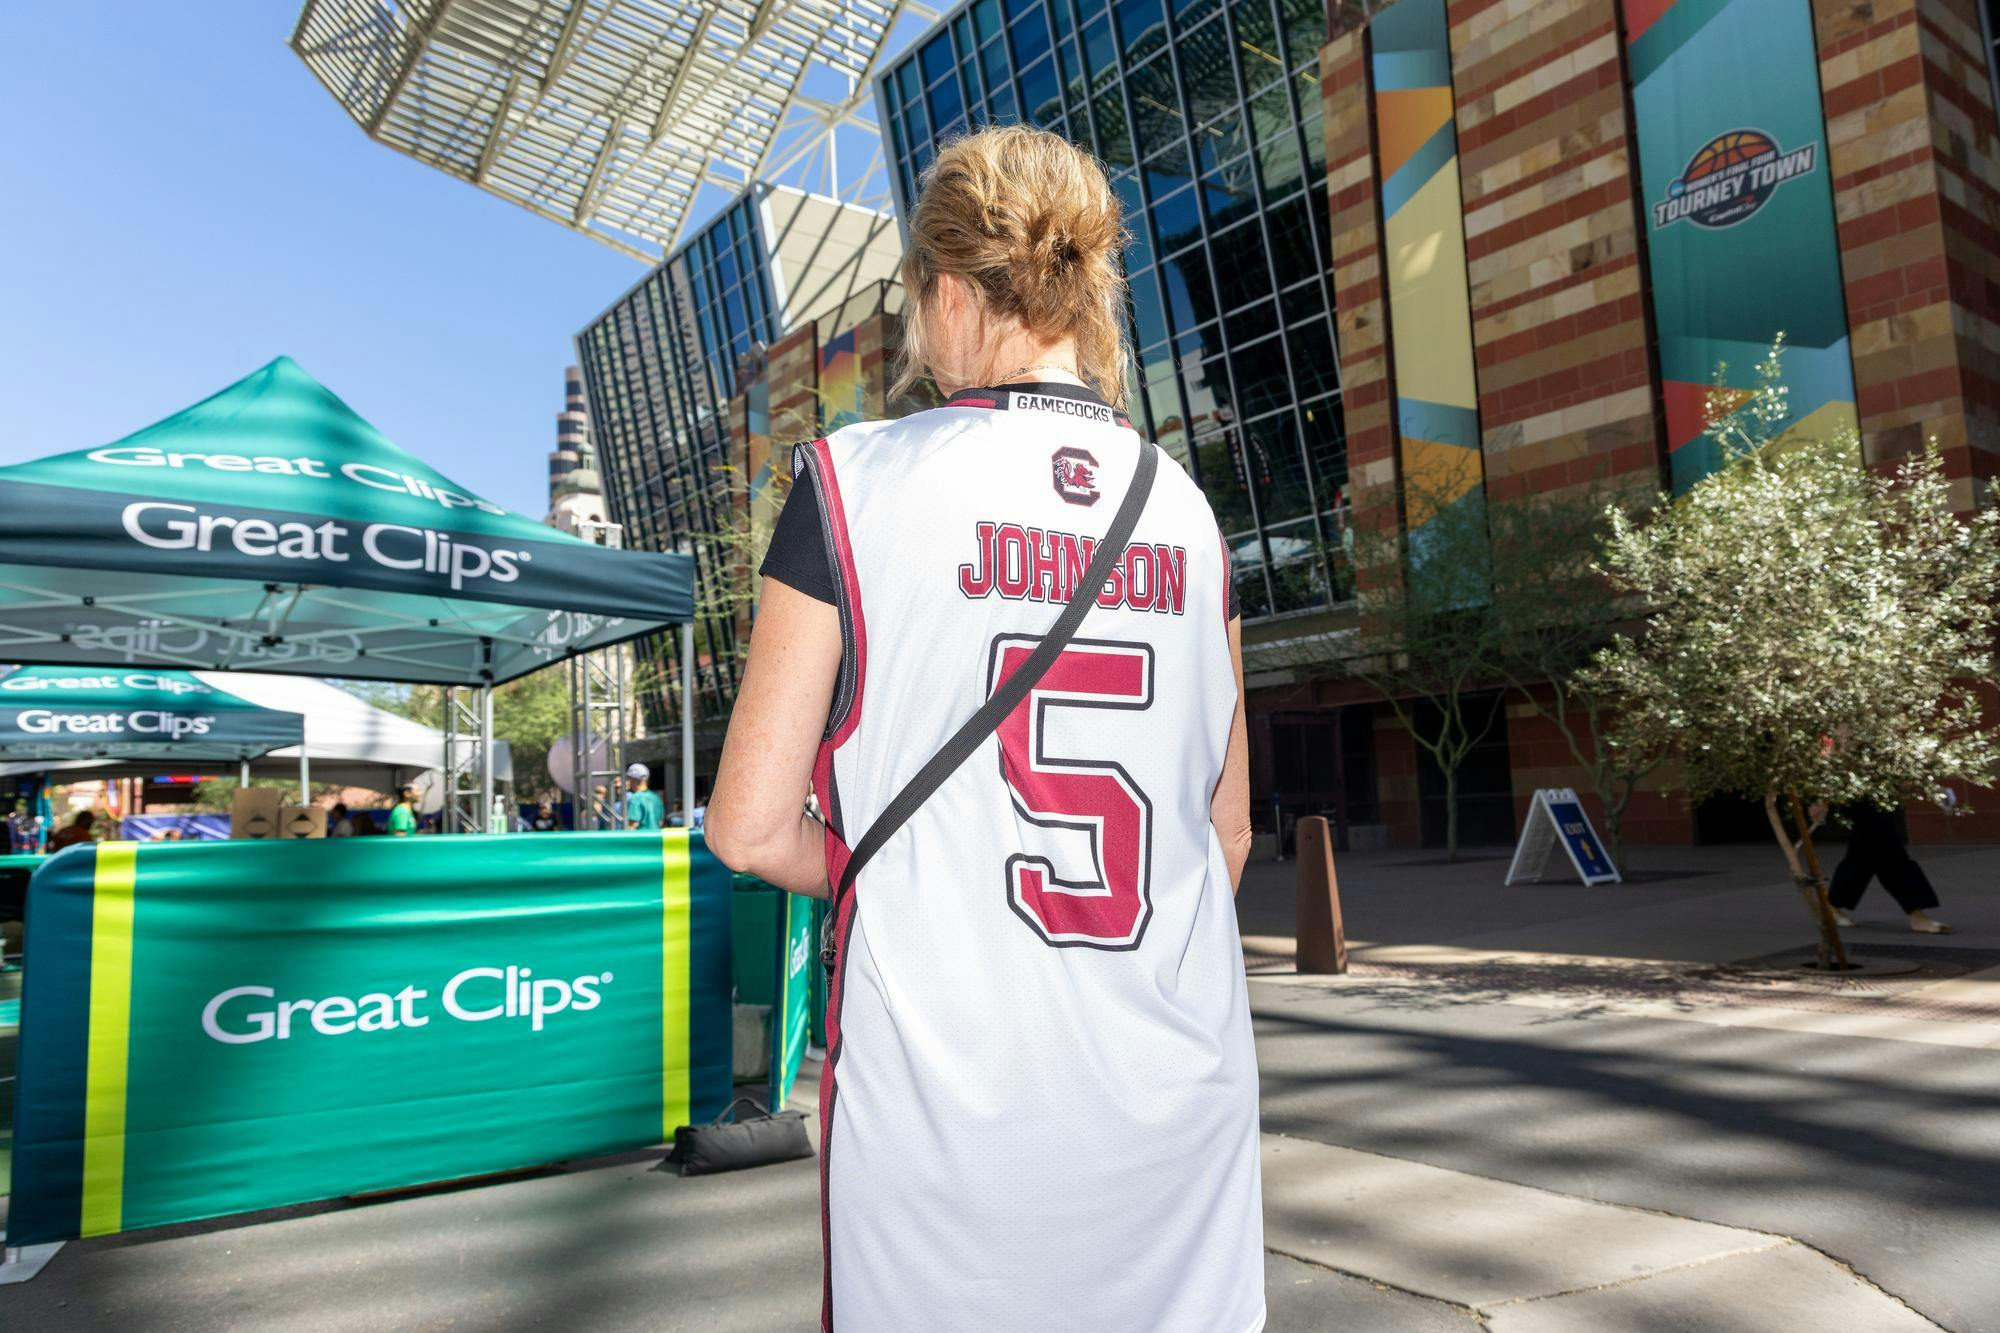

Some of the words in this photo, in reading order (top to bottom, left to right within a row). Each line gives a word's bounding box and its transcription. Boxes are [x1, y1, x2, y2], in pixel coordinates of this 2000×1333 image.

[1656, 174, 1748, 225] TOURNEY
[1750, 148, 1813, 190] TOWN
[1017, 395, 1110, 422] GAMECOCKS
[87, 447, 331, 478] Great
[340, 462, 509, 516] Clips
[121, 502, 350, 561] Great
[1, 674, 119, 691] Great
[16, 709, 124, 734] Great
[986, 632, 1156, 951] 5
[201, 984, 429, 1044] Great
